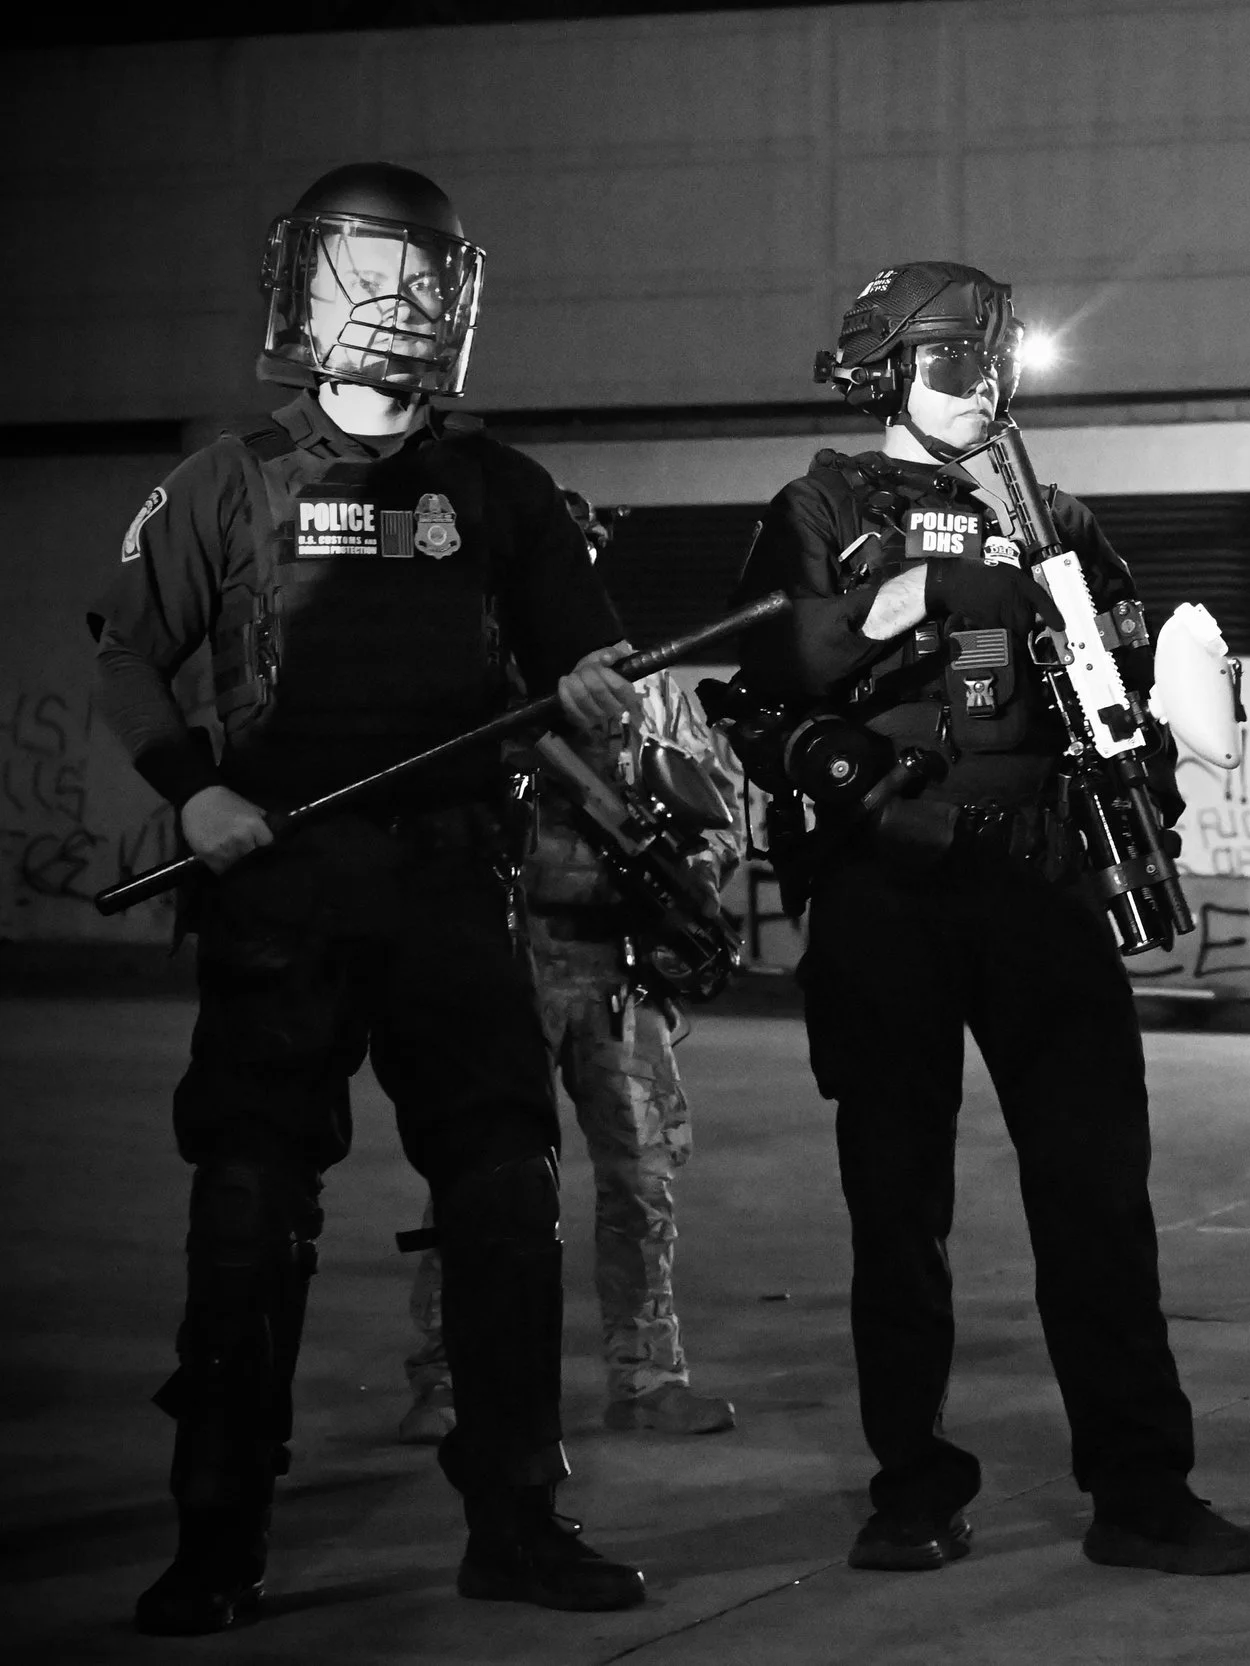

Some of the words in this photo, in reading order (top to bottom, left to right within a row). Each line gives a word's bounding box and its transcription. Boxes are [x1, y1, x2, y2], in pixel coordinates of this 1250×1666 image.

[300, 503, 375, 532] POLICE
[910, 512, 978, 534] POLICE
[318, 536, 362, 545] CUSTOMS
[922, 530, 964, 554] DHS
